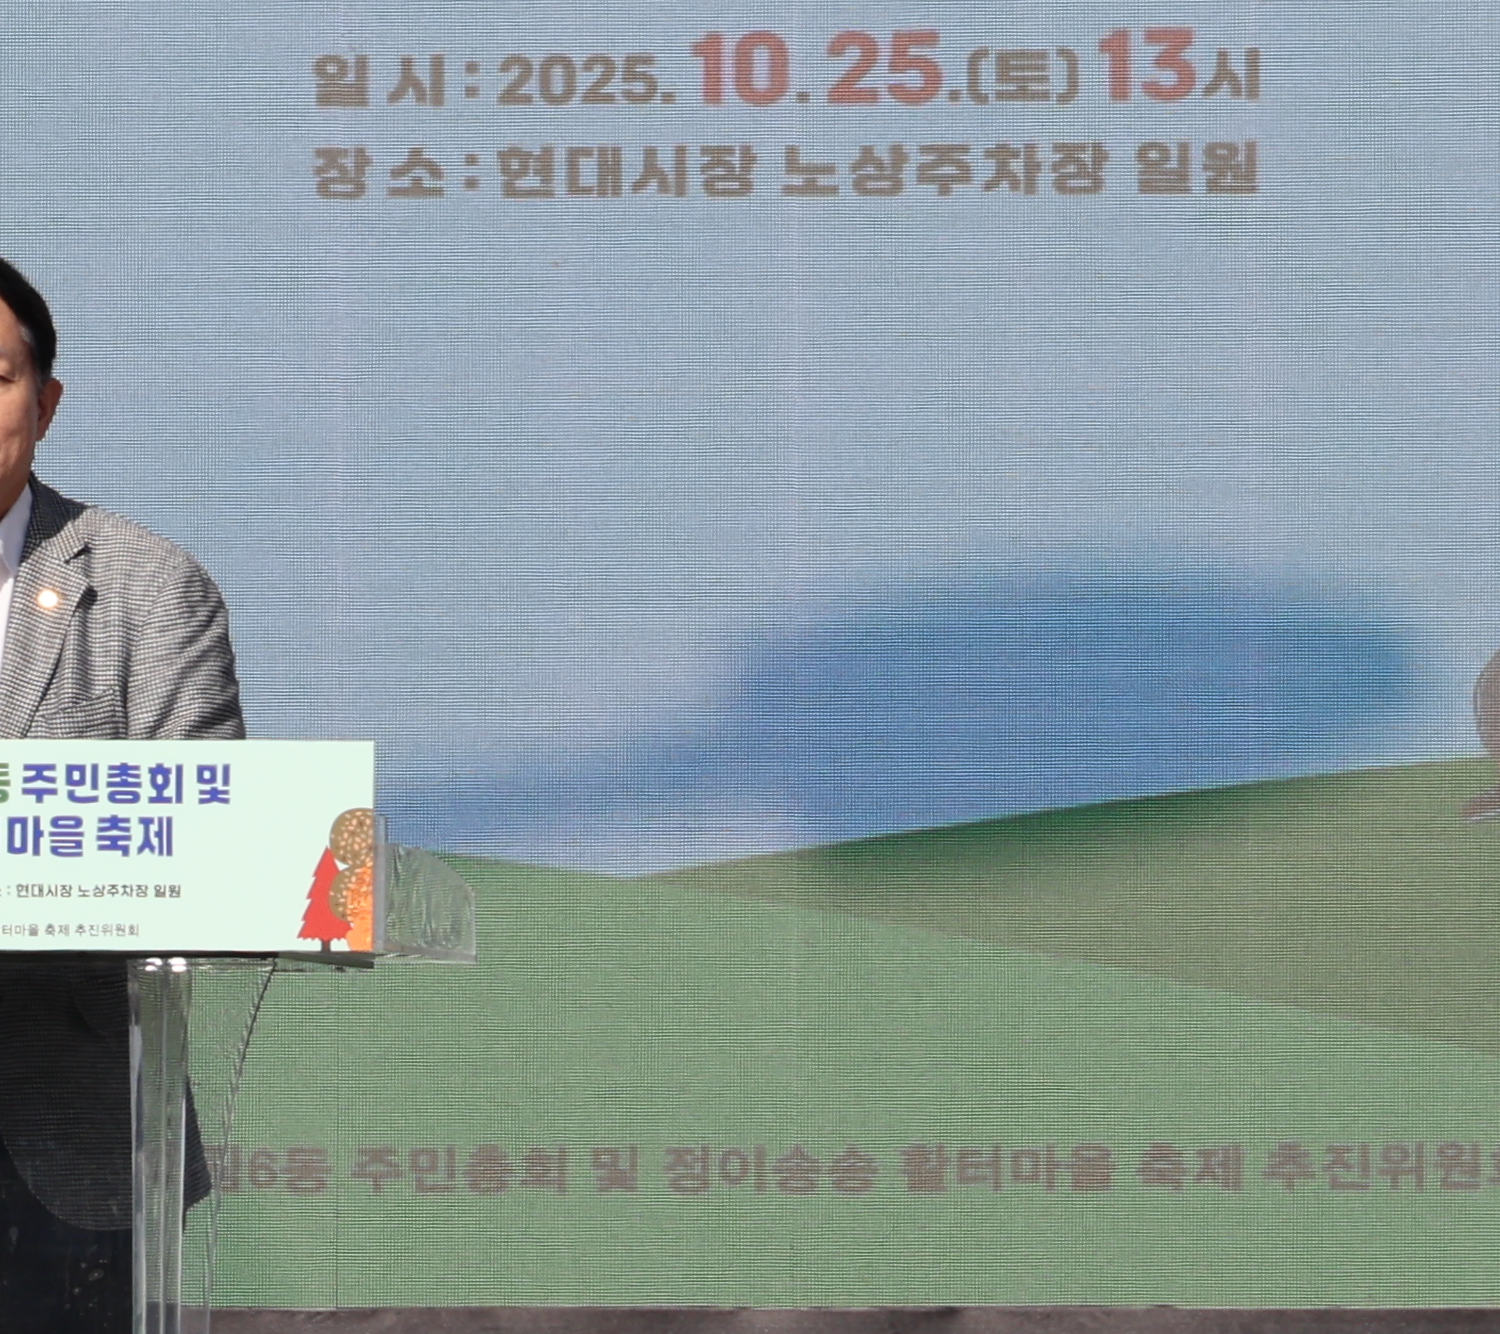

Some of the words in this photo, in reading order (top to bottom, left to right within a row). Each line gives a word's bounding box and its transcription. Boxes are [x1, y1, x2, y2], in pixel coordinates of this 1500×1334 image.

[497, 143, 757, 199] 현대시장
[782, 141, 1110, 198] 노상주차장
[1135, 140, 1260, 196] 일원
[21, 762, 184, 805] 주민총회
[196, 763, 232, 805] 및
[95, 814, 174, 857] 축제
